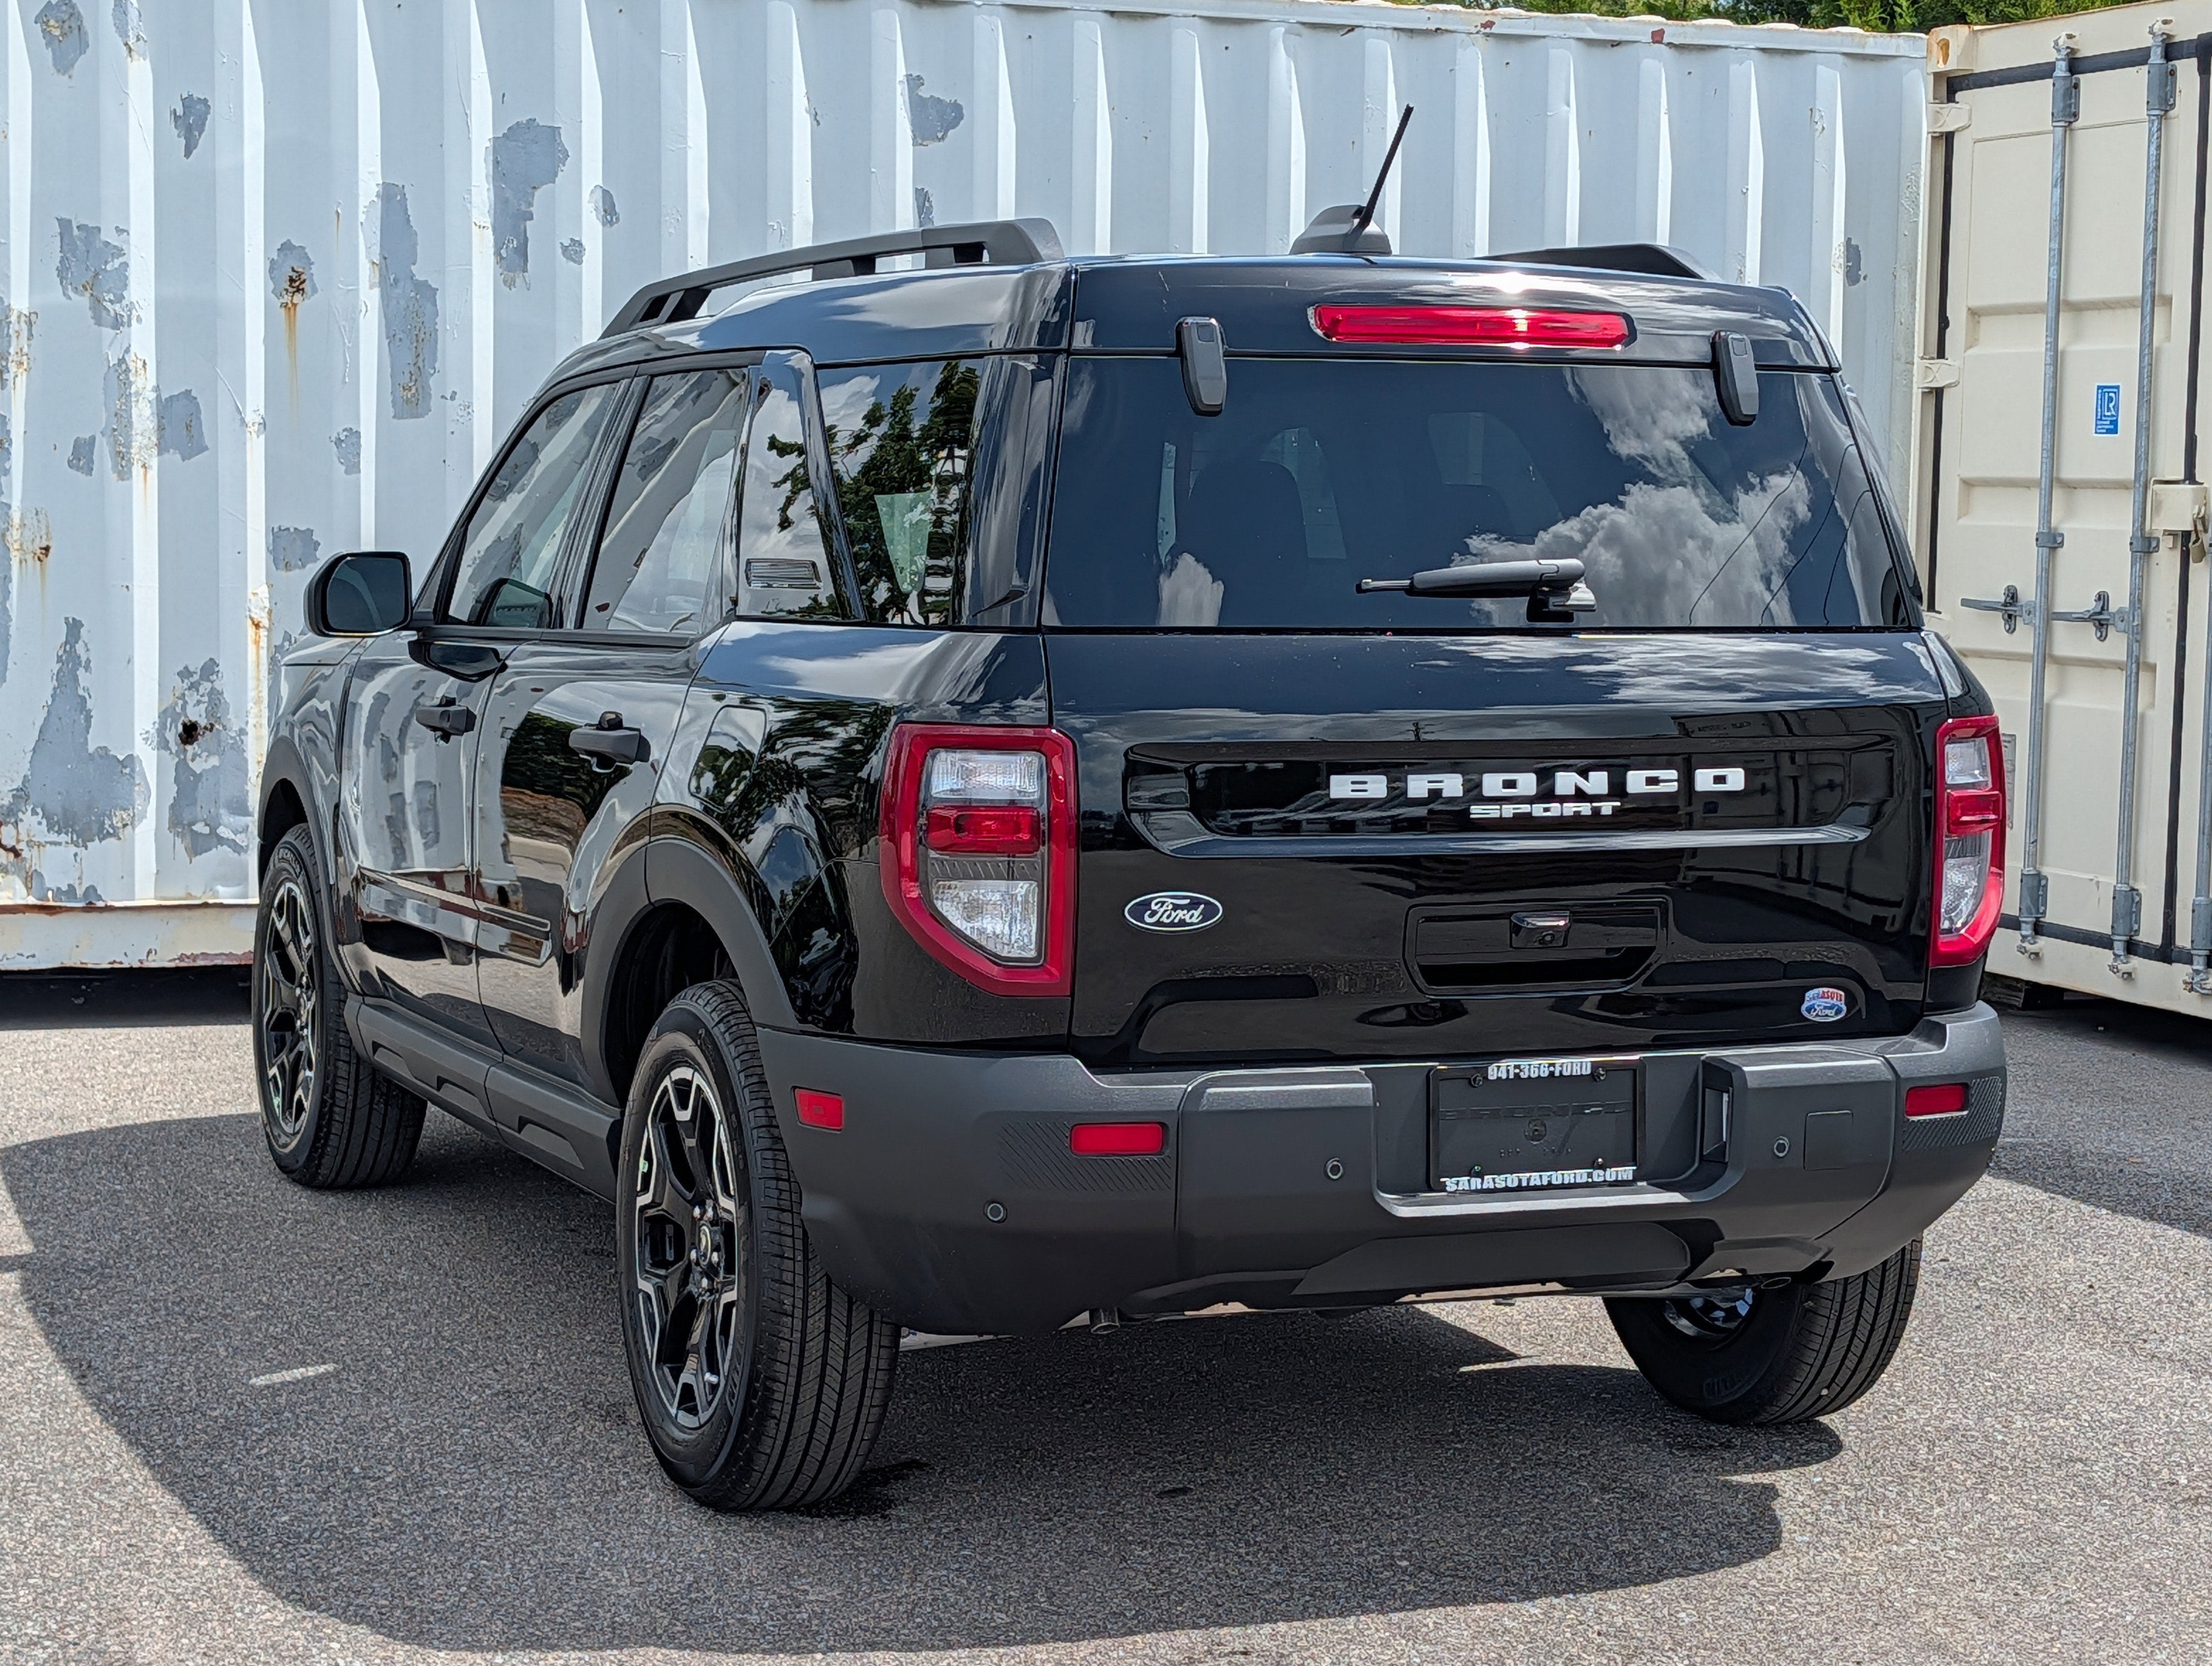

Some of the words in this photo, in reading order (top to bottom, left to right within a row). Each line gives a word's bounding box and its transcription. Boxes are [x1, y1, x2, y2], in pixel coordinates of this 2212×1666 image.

[1329, 768, 1745, 798] BRONCO
[1469, 802, 1621, 818] SPORT
[1144, 898, 1205, 923] Ford
[1810, 1003, 1838, 1017] Ford
[1487, 1061, 1592, 1081] 941-366-FORD
[1445, 1168, 1634, 1192] SARASOTAFORD.COM
